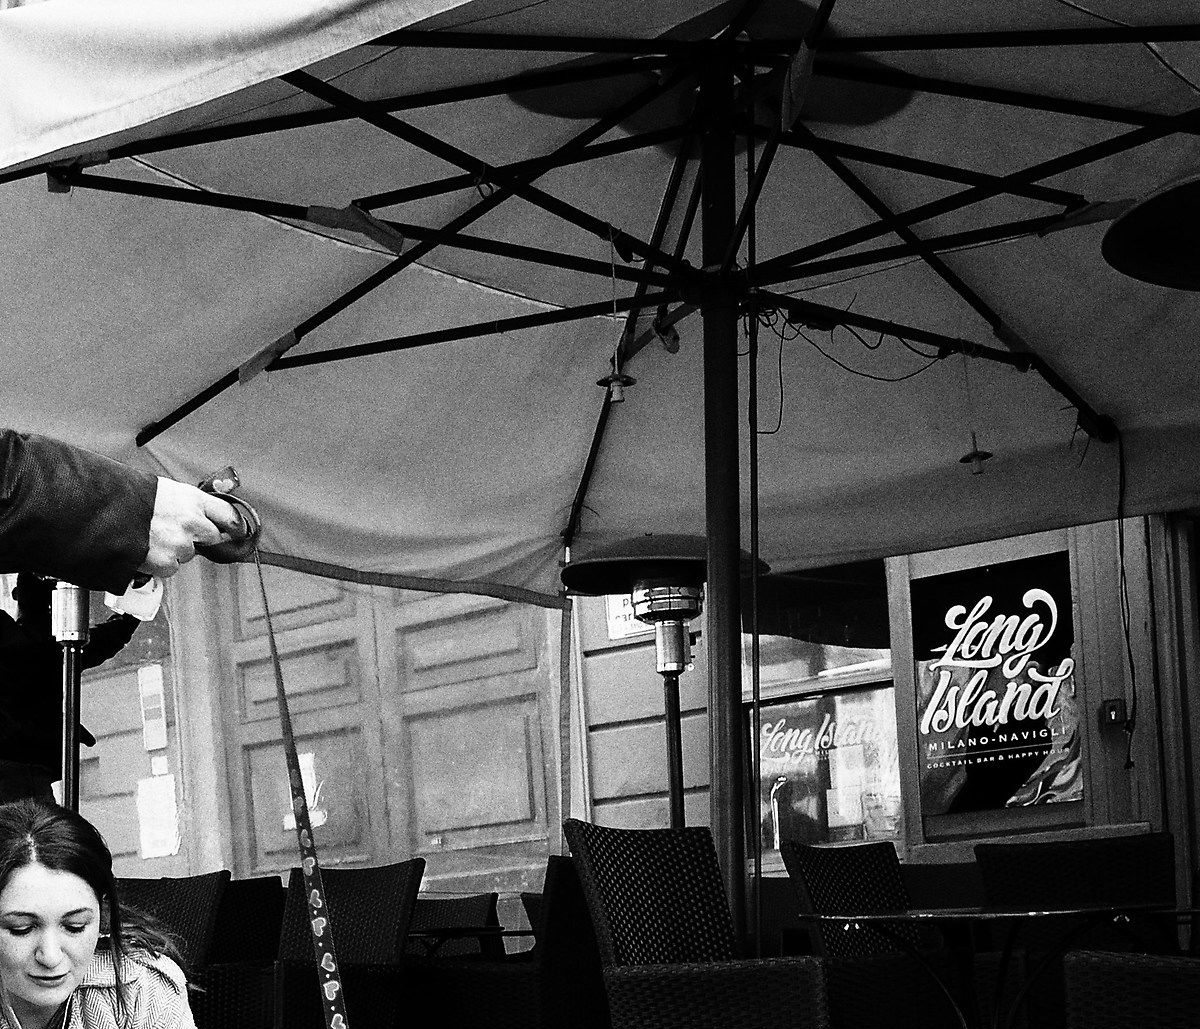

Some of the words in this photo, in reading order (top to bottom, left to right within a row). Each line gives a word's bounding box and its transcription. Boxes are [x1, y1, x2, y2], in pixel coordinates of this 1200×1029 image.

[928, 588, 1058, 679] Long
[920, 657, 1075, 735] Island
[761, 718, 814, 763] Long
[814, 712, 882, 750] Isan
[926, 759, 974, 770] COCKTAIL
[976, 756, 995, 764] BAR
[1008, 751, 1040, 760] HAPPY
[927, 726, 1067, 752] MILANO-NAVIGLI
